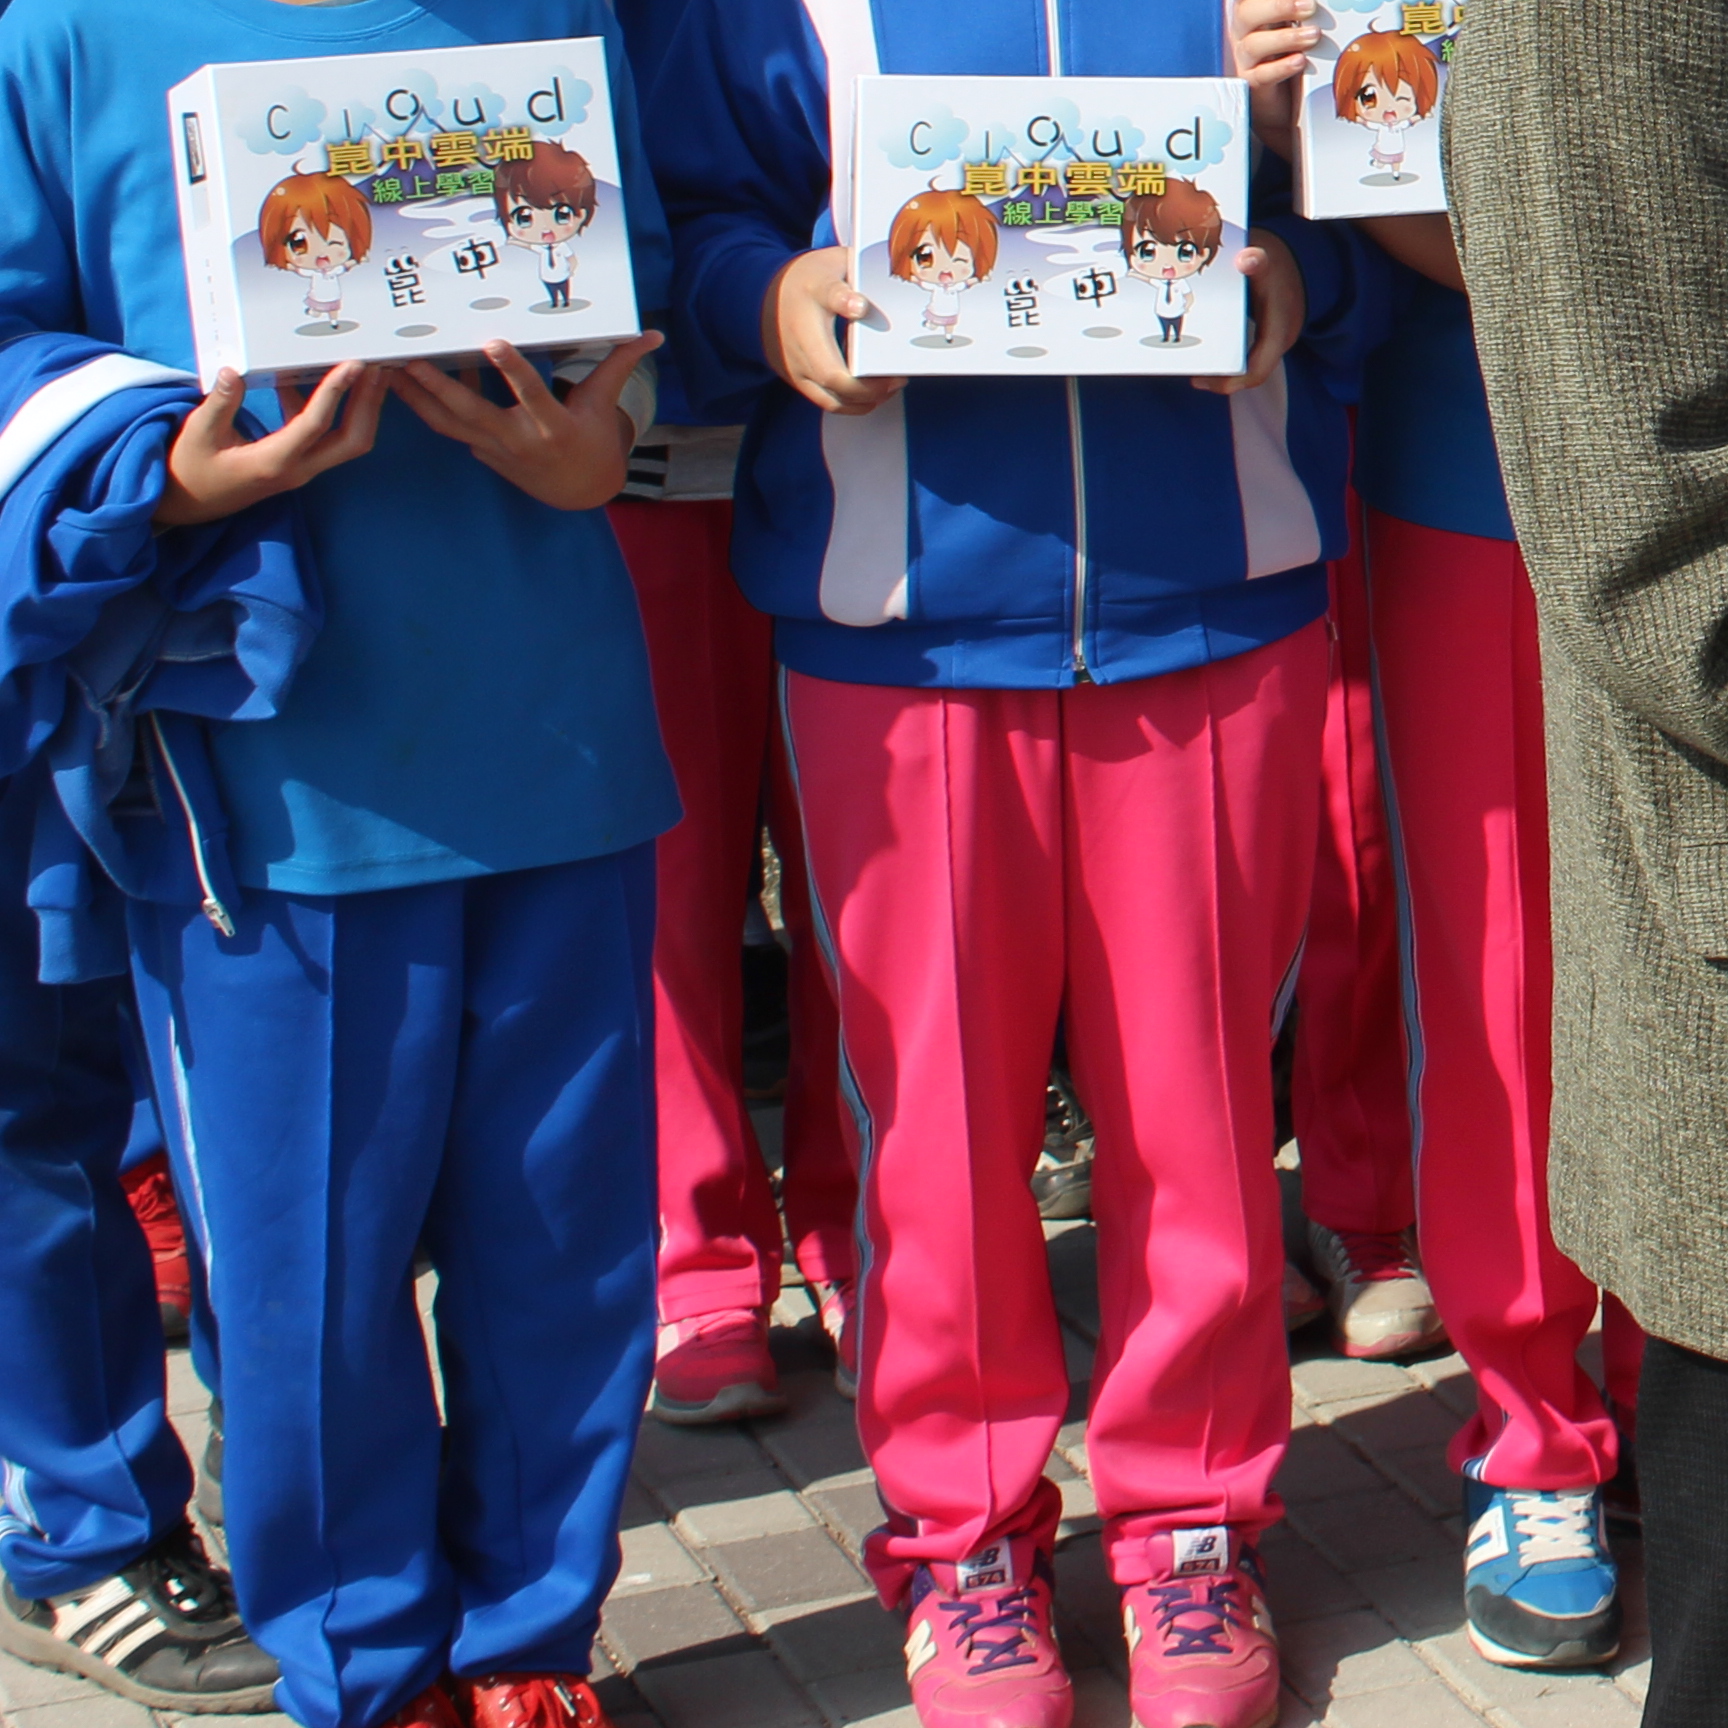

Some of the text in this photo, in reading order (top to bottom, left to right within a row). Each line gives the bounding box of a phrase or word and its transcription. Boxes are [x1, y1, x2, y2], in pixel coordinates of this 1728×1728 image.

[372, 171, 496, 205] 線上學習
[1003, 201, 1125, 227] 線上學習
